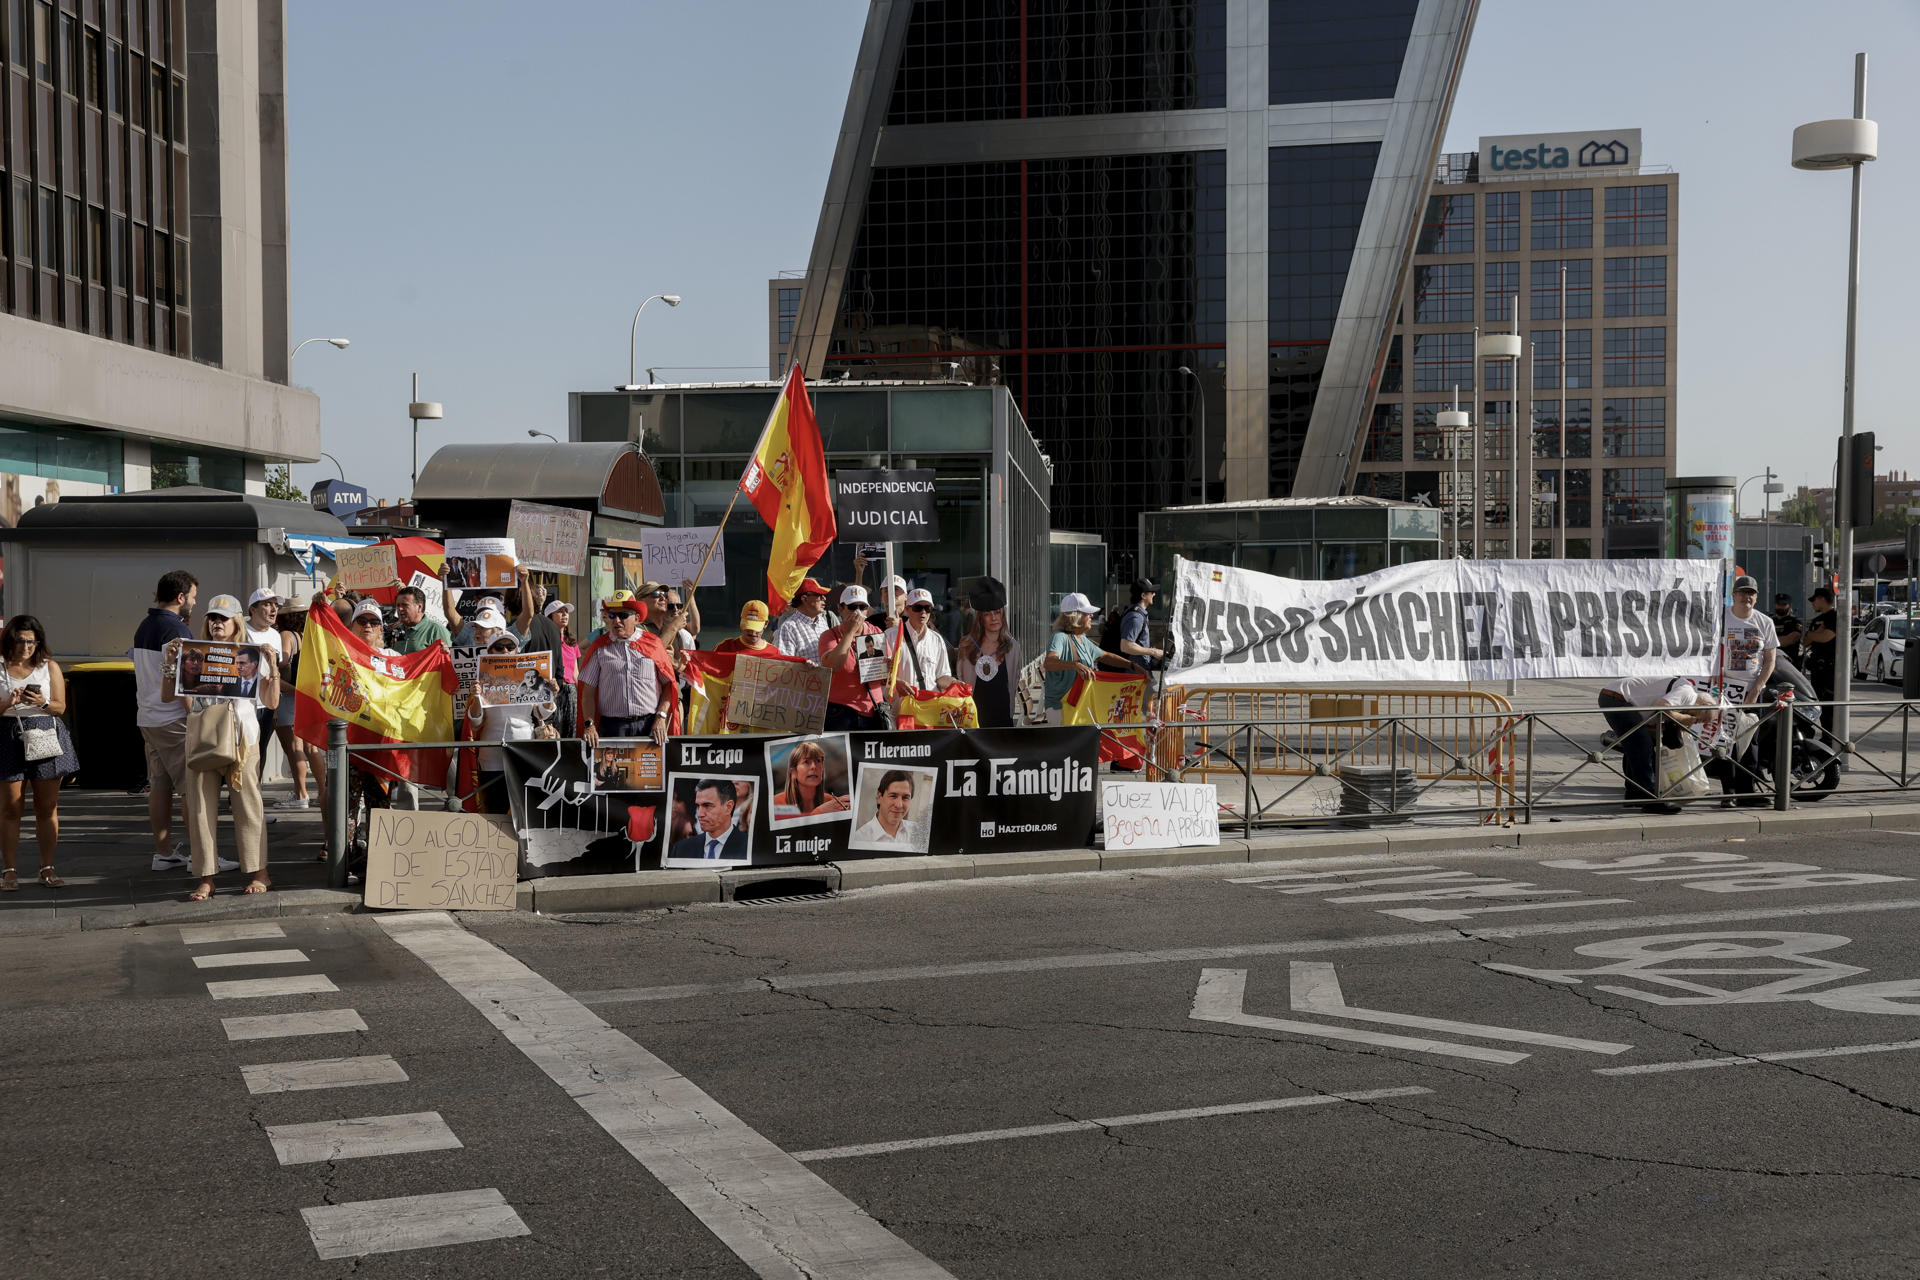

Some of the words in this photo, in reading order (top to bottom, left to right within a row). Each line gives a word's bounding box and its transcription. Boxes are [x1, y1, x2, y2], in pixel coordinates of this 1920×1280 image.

[1490, 143, 1569, 171] testa
[334, 492, 362, 504] ATM
[839, 481, 936, 494] INDEPENDENCIA
[849, 510, 928, 526] JUDICIAL
[1181, 596, 1314, 667] PEDRO
[1318, 585, 1503, 663] SÁNCHEZ
[1511, 591, 1543, 658] A
[1547, 577, 1713, 658] PRISIÓN
[200, 675, 221, 683] RESIGN
[222, 676, 237, 684] NOW
[483, 683, 517, 694] Fango
[510, 693, 550, 704] Franco
[743, 681, 826, 715] FEMINISTA
[735, 700, 787, 725] MUJER
[795, 710, 821, 732] DE
[707, 748, 743, 768] capo
[879, 741, 932, 759] hermano
[944, 759, 980, 798] La
[988, 755, 1093, 802] Famiglia
[1102, 784, 1153, 809] Juez
[1160, 786, 1216, 814] VALOR
[375, 815, 415, 848] NO
[424, 830, 445, 849] AL
[444, 817, 513, 851] GOLPE
[775, 835, 792, 854] La
[796, 836, 832, 855] mujer
[982, 829, 994, 837] HO
[393, 850, 429, 878] DE
[444, 850, 517, 880] ESTADO
[1538, 851, 1917, 893] BUS
[379, 880, 412, 906] DE
[1222, 865, 1635, 923] TAXI
